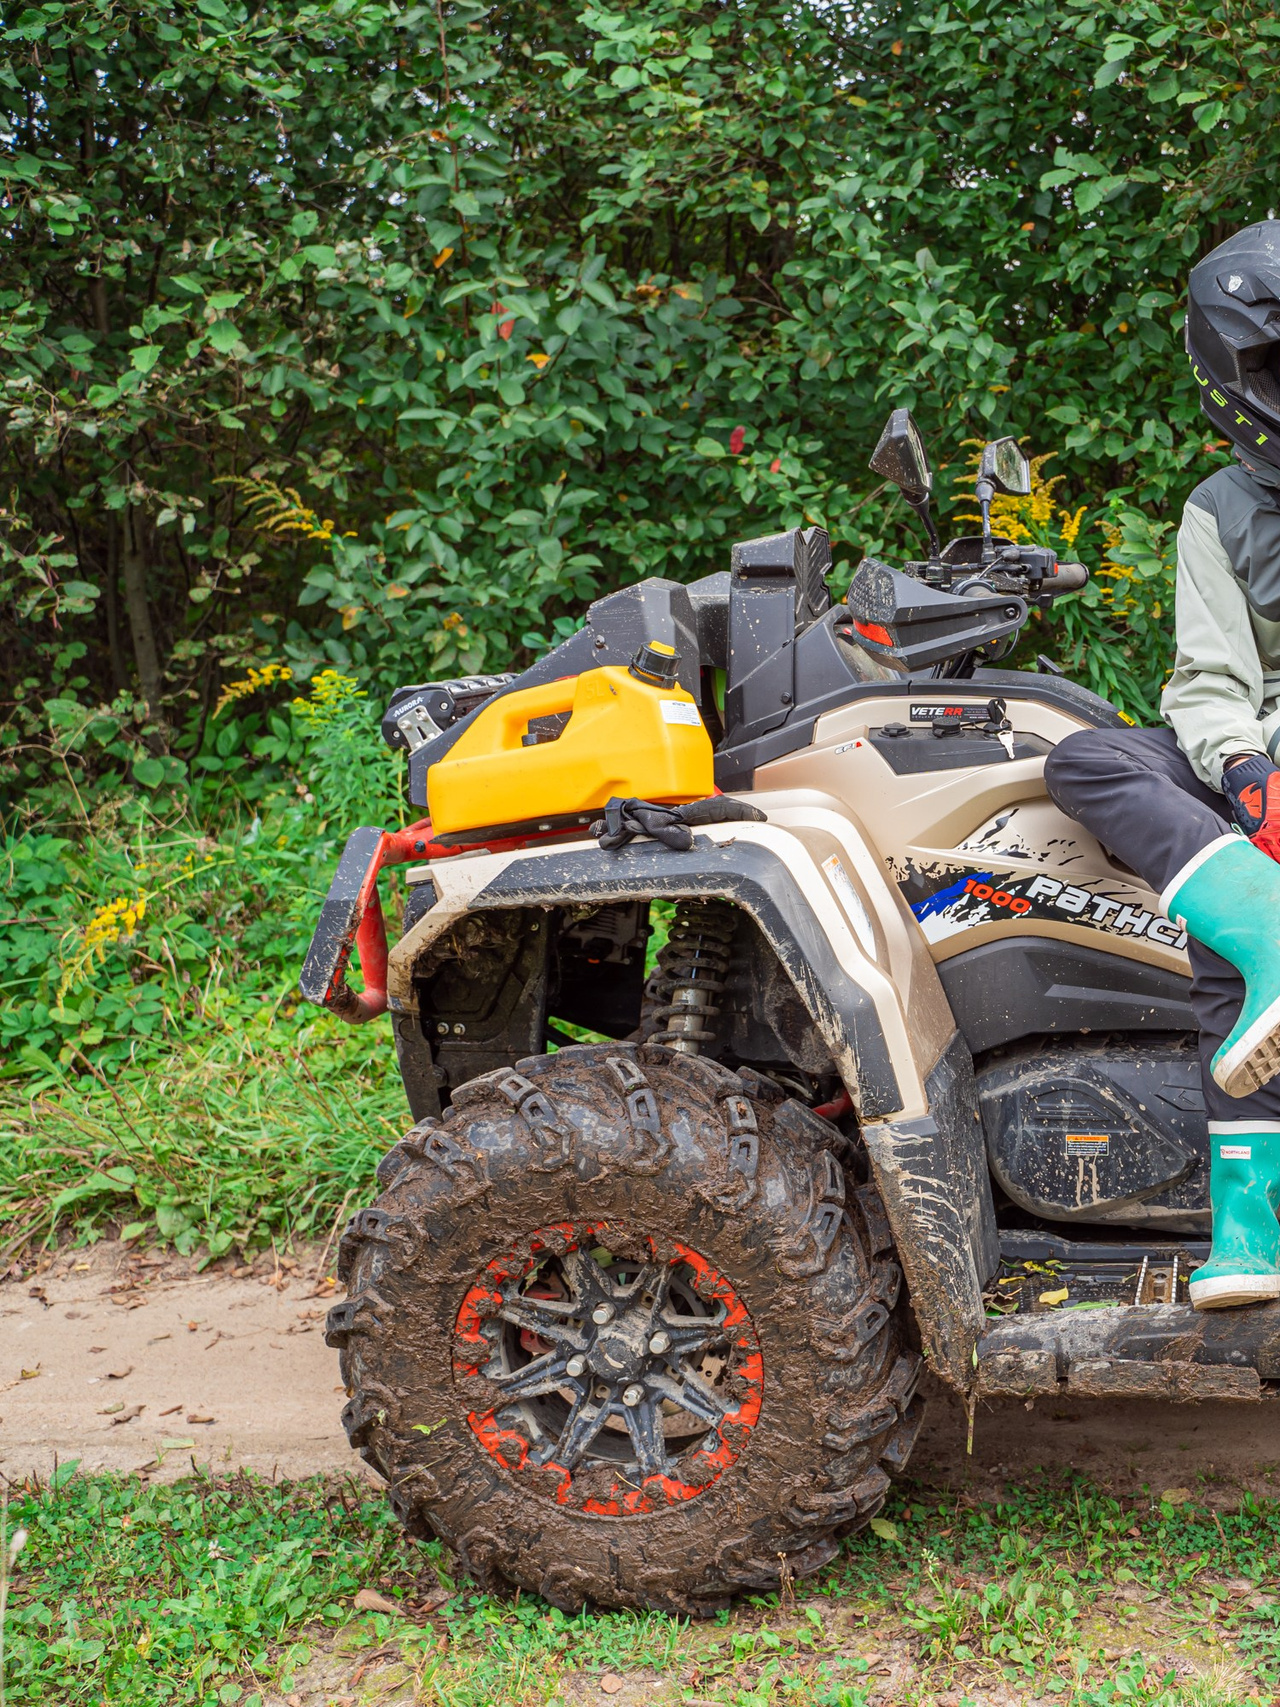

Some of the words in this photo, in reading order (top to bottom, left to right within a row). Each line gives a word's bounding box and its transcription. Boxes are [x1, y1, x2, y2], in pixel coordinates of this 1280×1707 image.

[1189, 354, 1268, 446] UST1
[393, 696, 424, 718] AURORA
[911, 707, 963, 716] VETERR
[963, 878, 1032, 914] 1000
